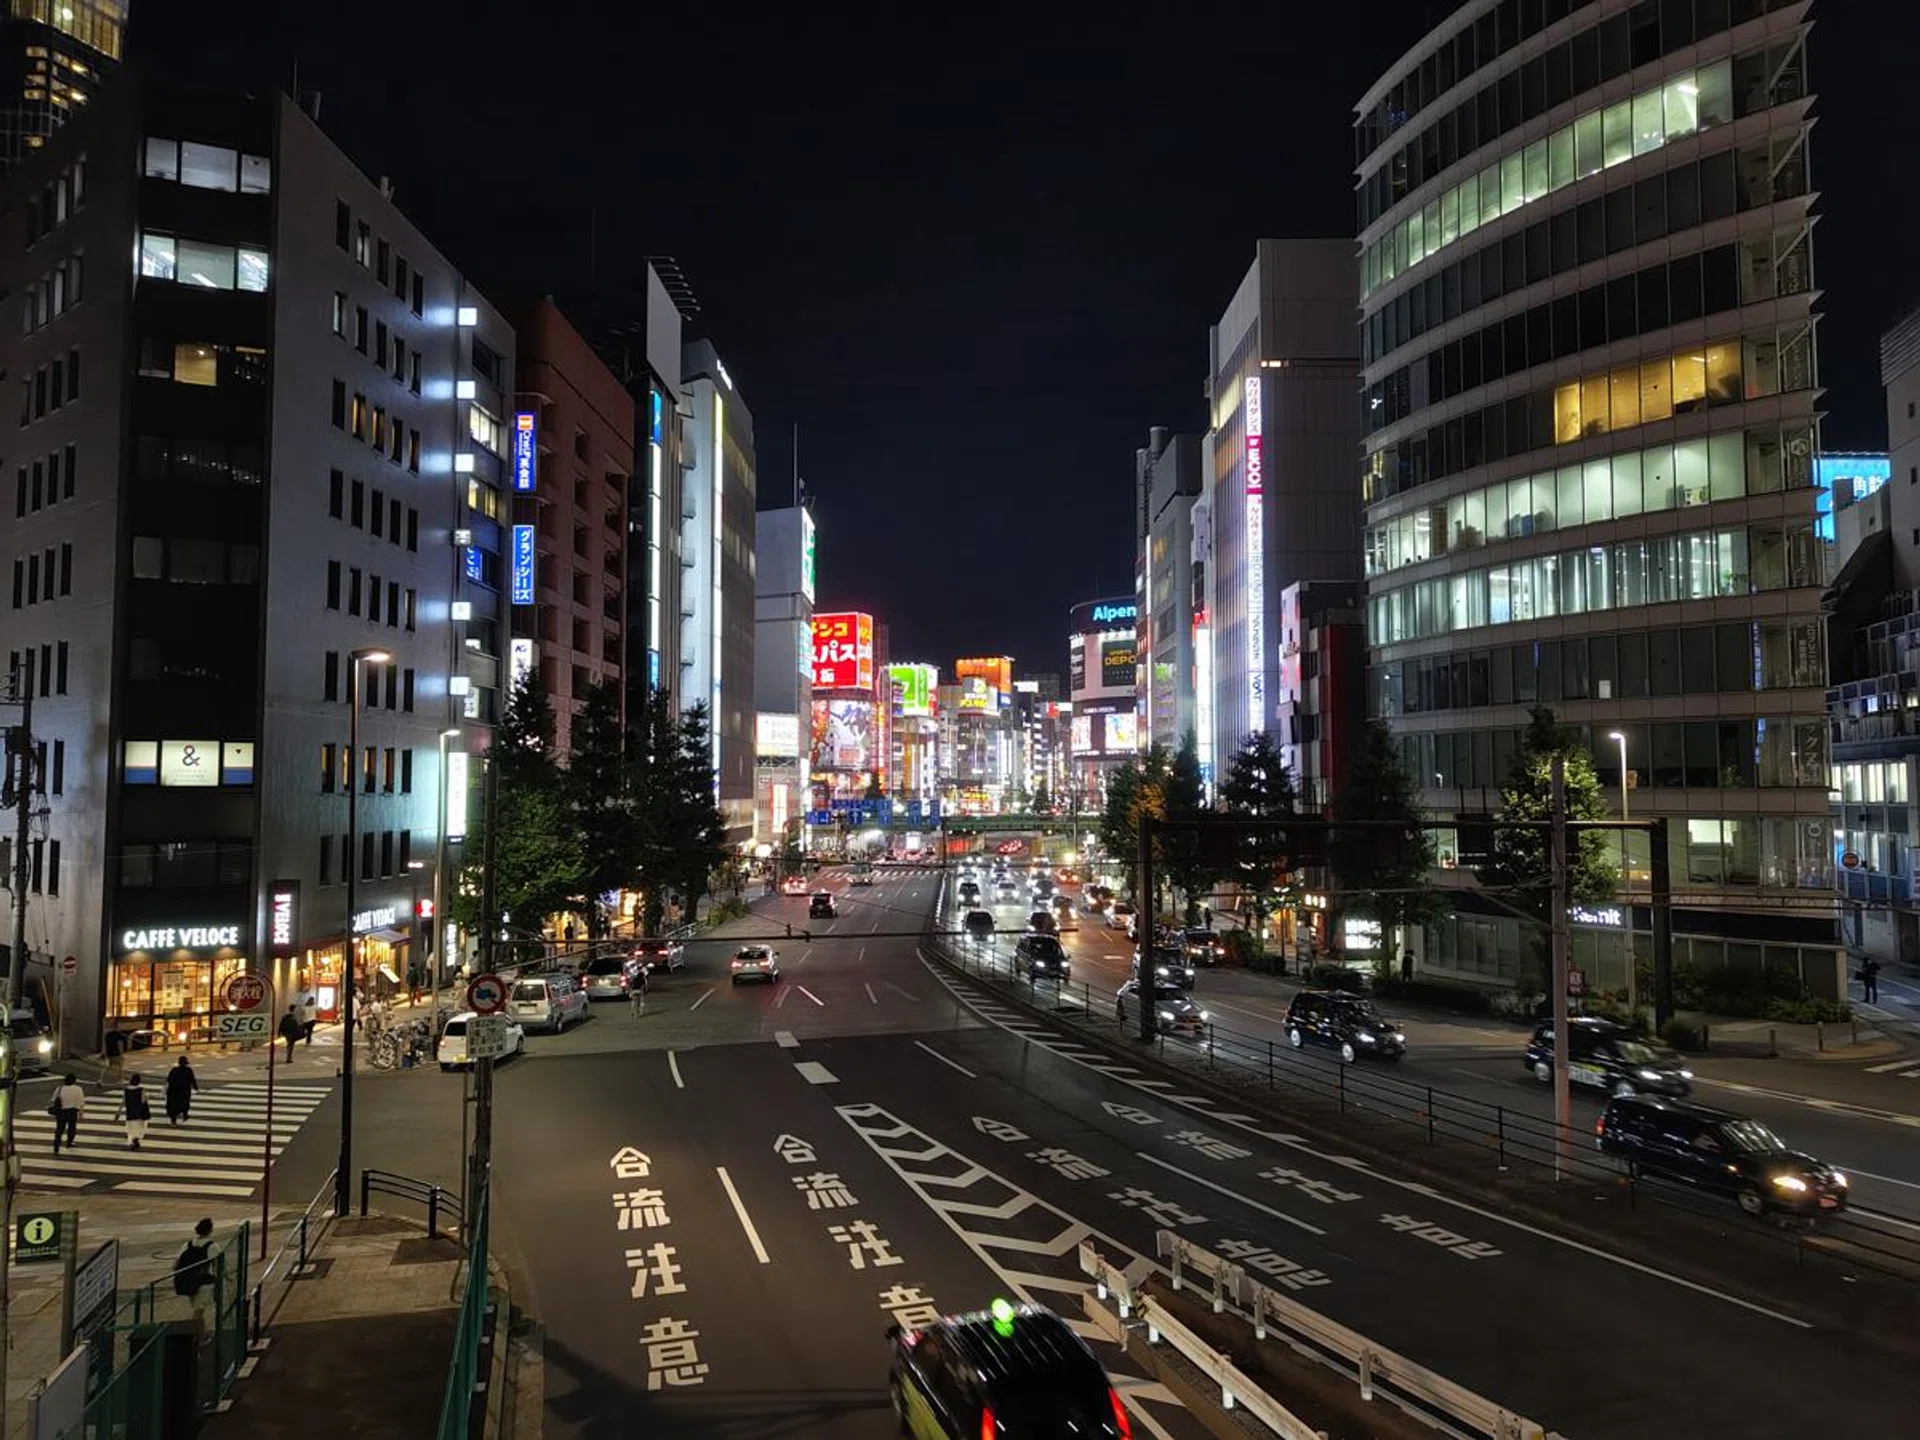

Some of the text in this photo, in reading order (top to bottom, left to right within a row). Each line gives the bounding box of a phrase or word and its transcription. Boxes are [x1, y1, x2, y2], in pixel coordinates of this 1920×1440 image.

[519, 529, 532, 600] グランシーズ
[1093, 605, 1137, 622] Alpen
[1104, 655, 1137, 666] DEPO
[273, 901, 291, 945] VELOCE
[373, 906, 395, 927] VELOCE
[178, 926, 239, 947] VELOCE
[220, 1016, 265, 1033] SEG
[1100, 1101, 1504, 1259] 合流注意
[970, 1116, 1332, 1290] 合流注意
[610, 1146, 709, 1390] 合流注意
